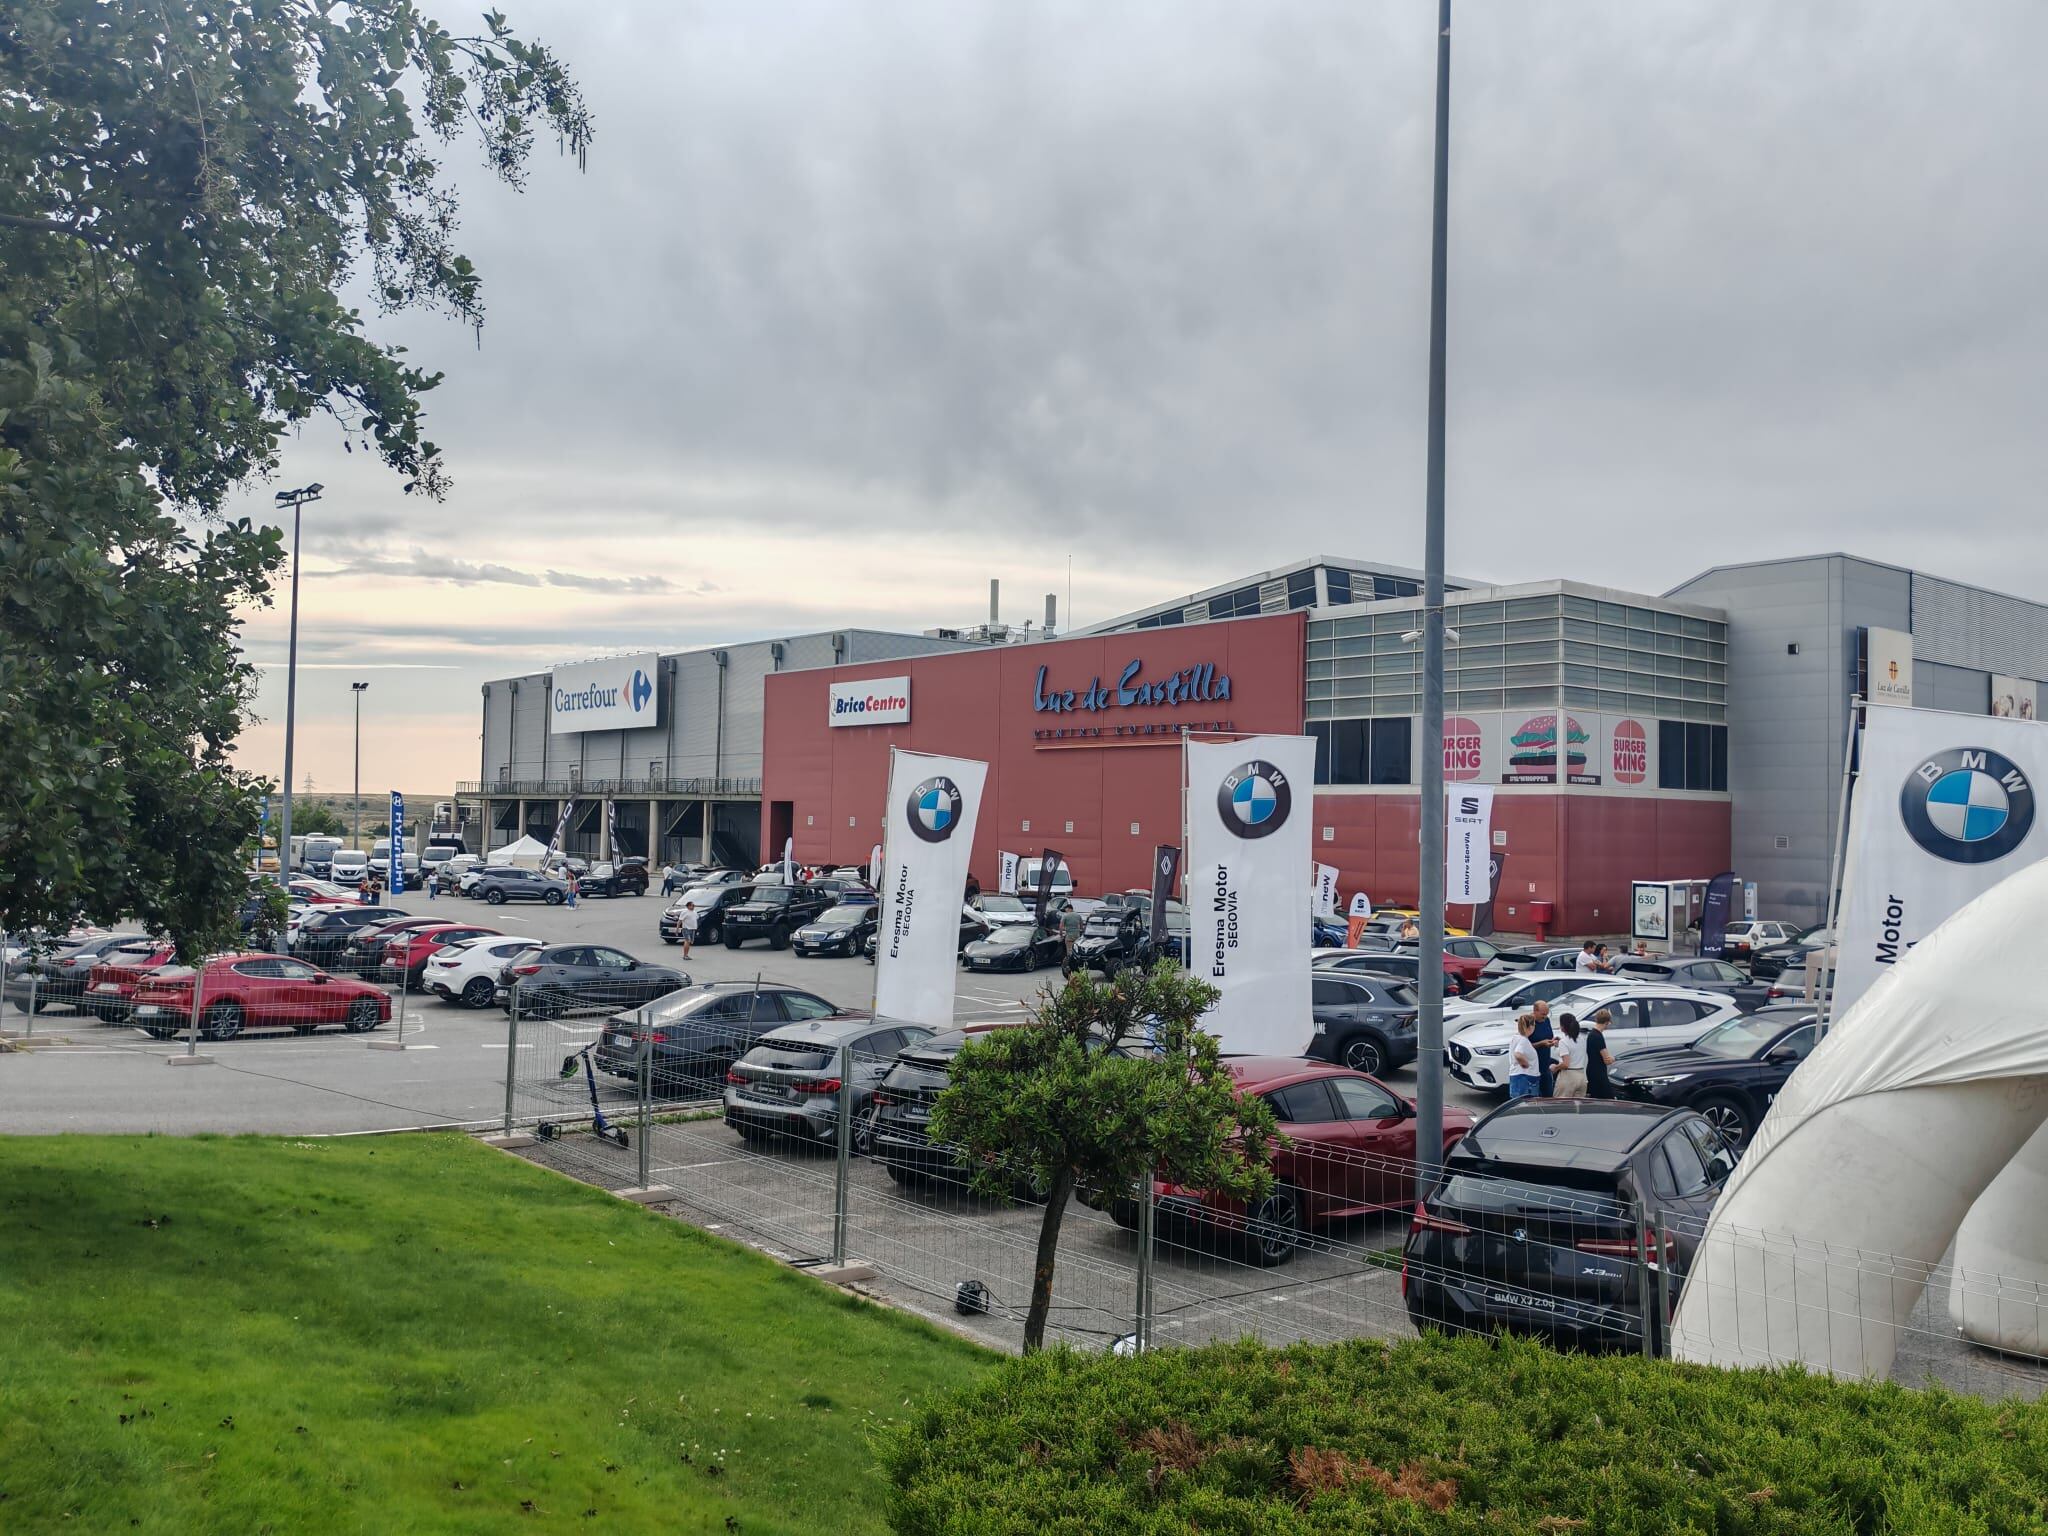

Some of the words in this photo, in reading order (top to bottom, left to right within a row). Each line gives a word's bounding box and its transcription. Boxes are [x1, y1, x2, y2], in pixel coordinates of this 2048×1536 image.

[555, 682, 618, 713] Carrefour
[1033, 664, 1075, 713] Luz
[1081, 675, 1109, 712] de
[1117, 657, 1232, 706] Castilla
[836, 695, 907, 714] BricoCentro
[1443, 736, 1481, 750] URGER
[1614, 738, 1646, 754] BURGER
[1444, 750, 1481, 769] ING
[1614, 753, 1646, 773] KING
[1916, 750, 2028, 794] BMW
[915, 778, 960, 801] BMW
[1225, 761, 1286, 791] BMW
[1454, 816, 1484, 825] SEAT
[394, 812, 403, 887] HYUNDAI
[896, 863, 909, 905] Motor
[1213, 864, 1228, 912] Motor
[902, 889, 915, 937] SEGOVIA
[1637, 894, 1657, 905] 630
[1227, 890, 1239, 948] SEGOVIA
[1875, 894, 1904, 964] Motor
[890, 909, 904, 960] Eresma
[1212, 918, 1226, 977] Eresma
[1582, 1267, 1606, 1276] X3
[1494, 1293, 1519, 1304] BMW
